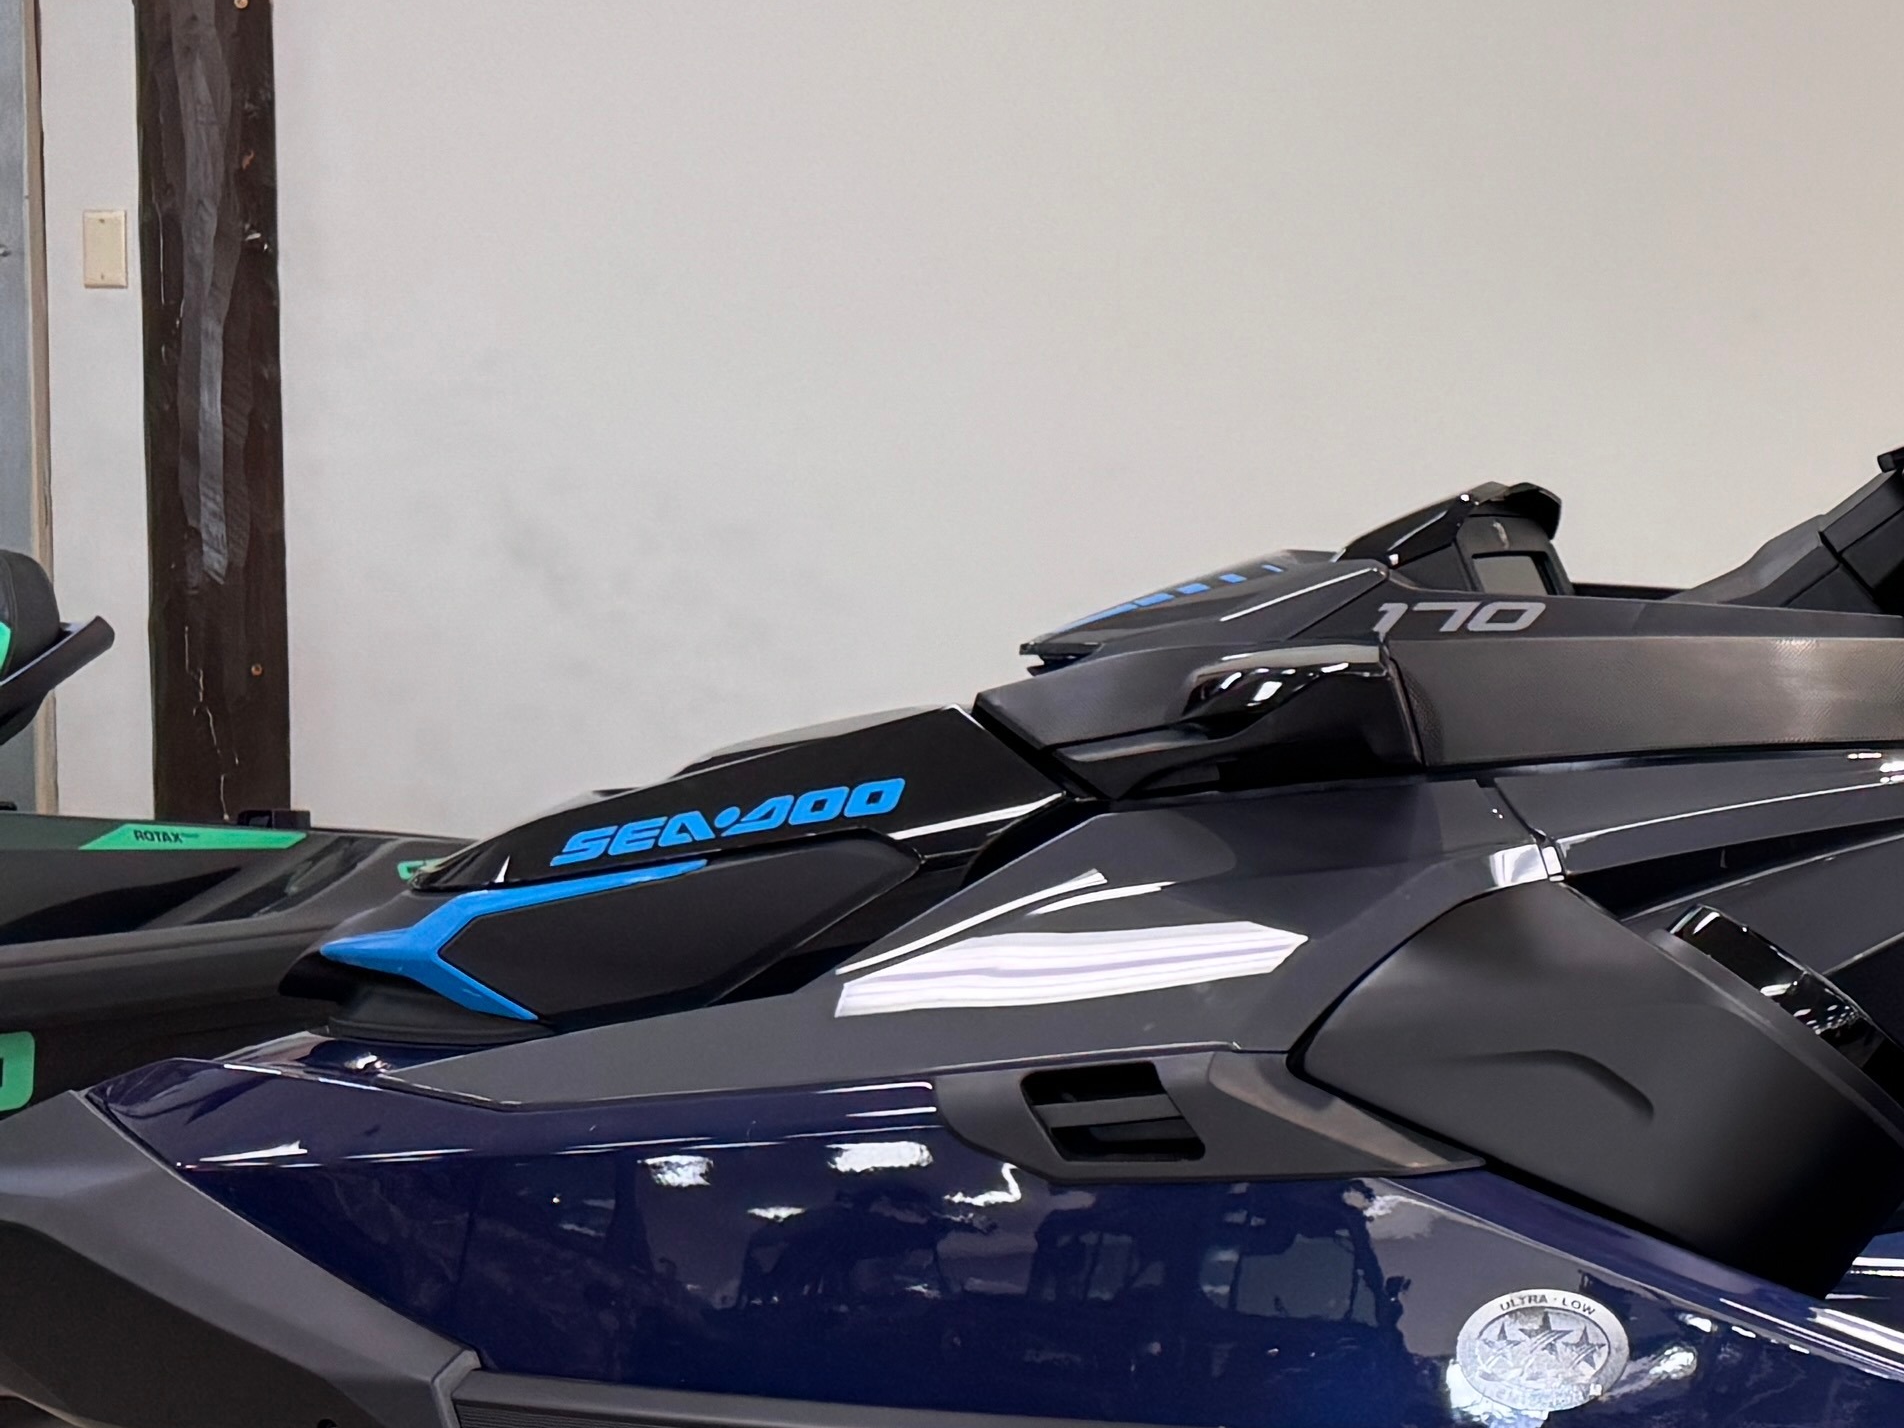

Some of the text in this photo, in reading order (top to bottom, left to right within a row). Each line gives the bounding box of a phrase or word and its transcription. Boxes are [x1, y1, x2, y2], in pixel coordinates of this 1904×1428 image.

[1372, 602, 1546, 633] 170
[133, 829, 183, 844] ROTAX
[1499, 1293, 1597, 1316] ULTRA LOW
